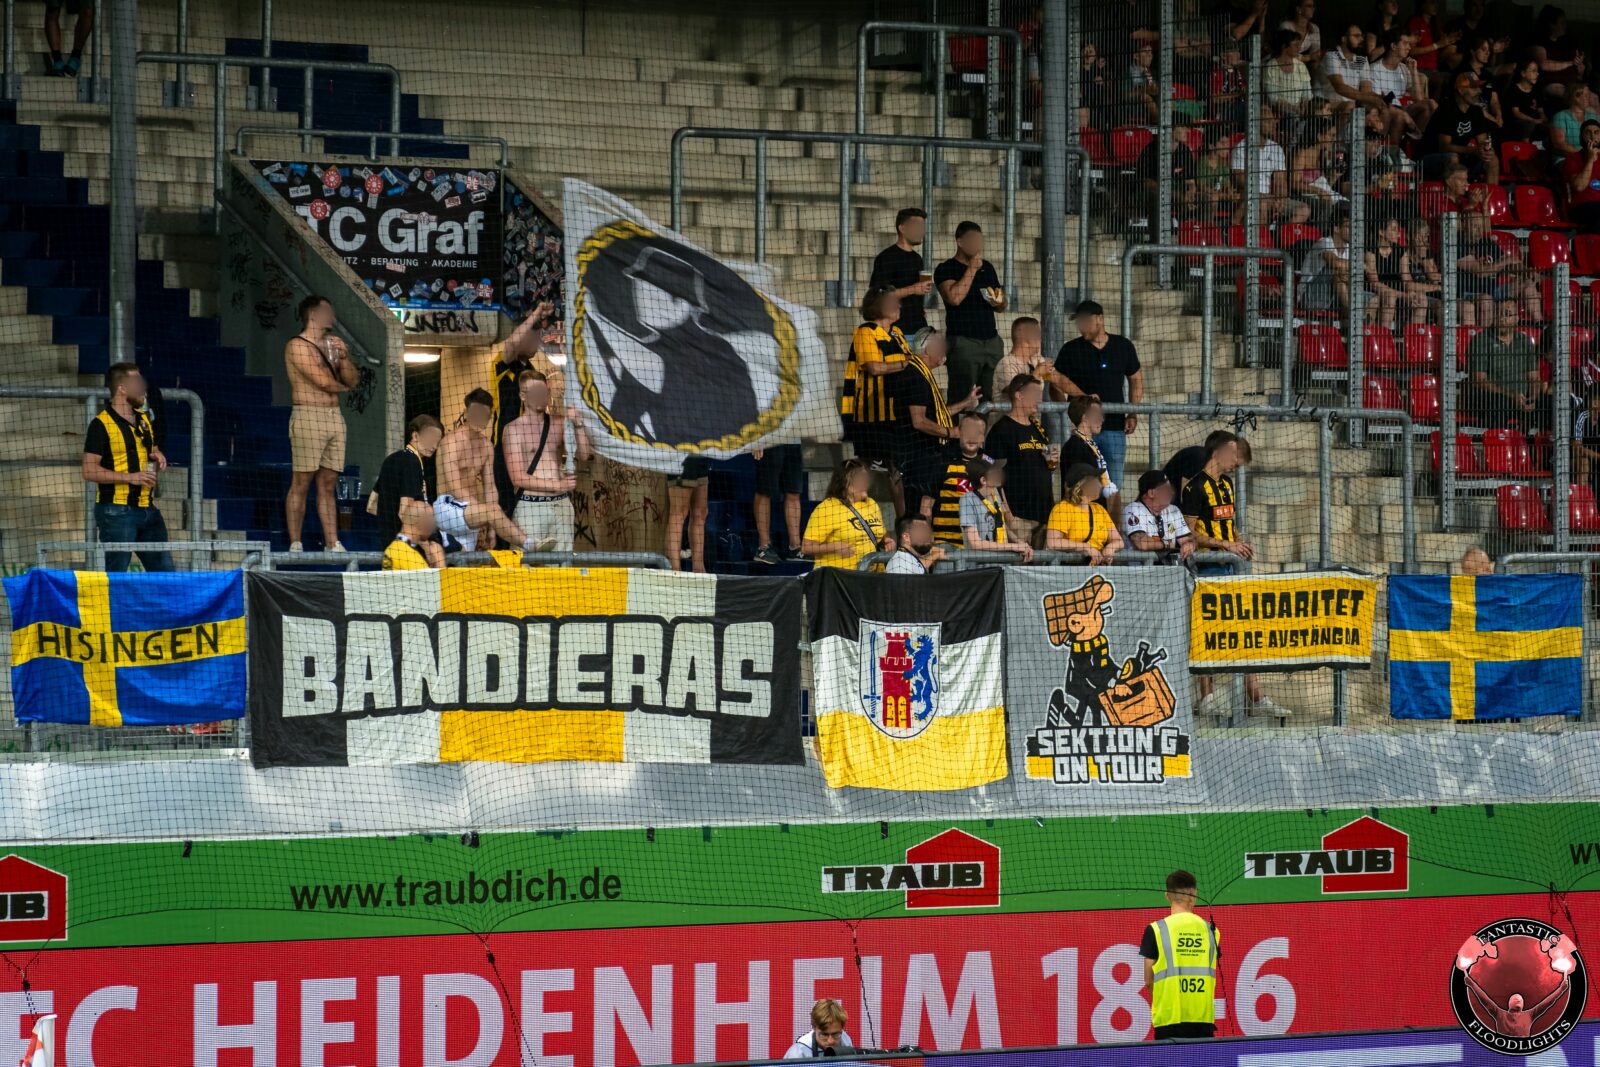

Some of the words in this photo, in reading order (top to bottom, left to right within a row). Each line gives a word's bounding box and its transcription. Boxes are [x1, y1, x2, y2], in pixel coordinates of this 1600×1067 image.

[378, 207, 485, 255] Graf
[370, 257, 419, 267] BERATUNG
[431, 259, 478, 269] AKADEMIE
[1201, 588, 1364, 621] SOLIDARITET
[37, 622, 219, 664] HISINGEN
[1205, 631, 1239, 651] MED
[1244, 630, 1263, 649] DE
[281, 614, 775, 718] BANDIERAS
[1037, 726, 1154, 756] SEKTION
[1160, 727, 1178, 756] G
[1054, 755, 1088, 782] ON
[1094, 755, 1163, 782] TOUR
[1246, 849, 1392, 877] TRAUB
[1569, 842, 1600, 865] w
[289, 867, 622, 911] www.traubdich.de
[823, 862, 983, 892] TRAUB
[1177, 937, 1203, 948] SDS
[193, 950, 1003, 1067] HEIDENHEIM
[1041, 936, 1297, 1045] 186
